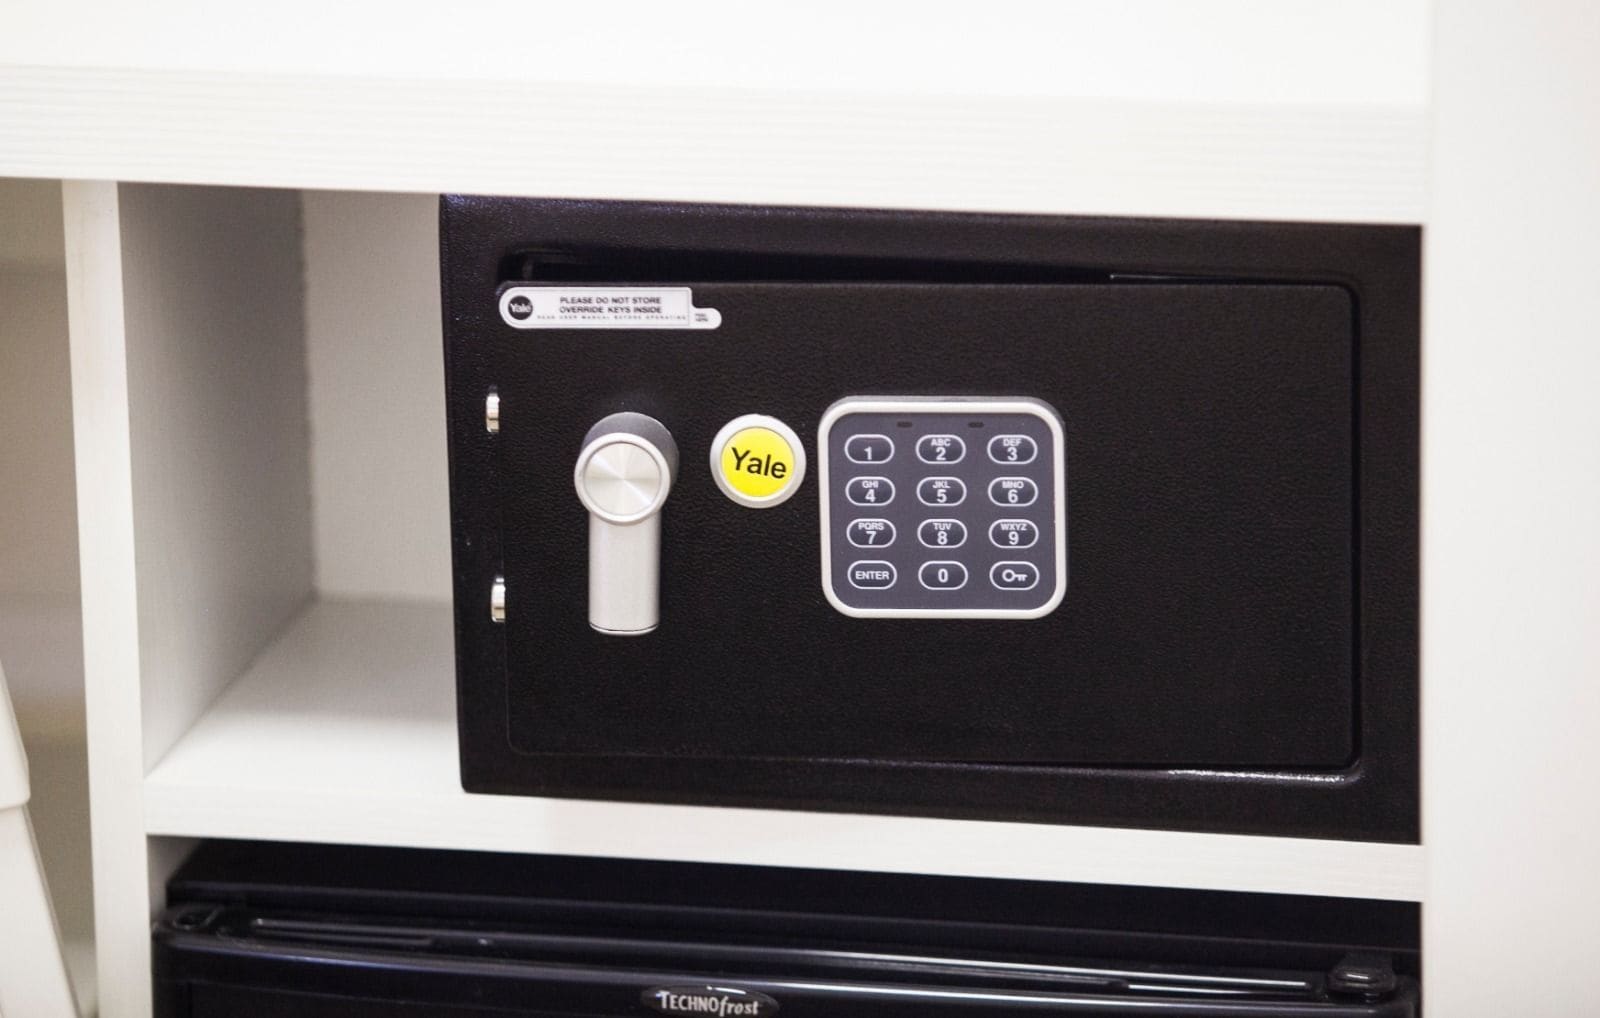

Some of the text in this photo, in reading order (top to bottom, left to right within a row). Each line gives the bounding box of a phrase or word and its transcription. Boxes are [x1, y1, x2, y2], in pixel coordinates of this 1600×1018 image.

[510, 303, 532, 313] Yale
[608, 306, 631, 314] KEYS
[633, 306, 662, 314] INSIDE
[931, 438, 951, 447] ABC
[1003, 438, 1022, 447] DEF
[863, 446, 873, 460] 1
[936, 447, 946, 461] 2
[1007, 447, 1018, 461] 3
[731, 447, 787, 479] Yale
[862, 480, 879, 489] GHI
[933, 480, 950, 489] JKL
[1002, 480, 1024, 489] MNO
[865, 489, 876, 502] 4
[936, 489, 947, 503] 5
[1007, 489, 1018, 503] 6
[858, 522, 884, 531] PQRS
[933, 522, 951, 531] TUV
[1000, 523, 1027, 532] WXYZ
[866, 531, 877, 545] 7
[937, 531, 948, 545] 8
[1008, 531, 1019, 545] 9
[855, 570, 890, 581] ENTER
[938, 568, 948, 583] 0
